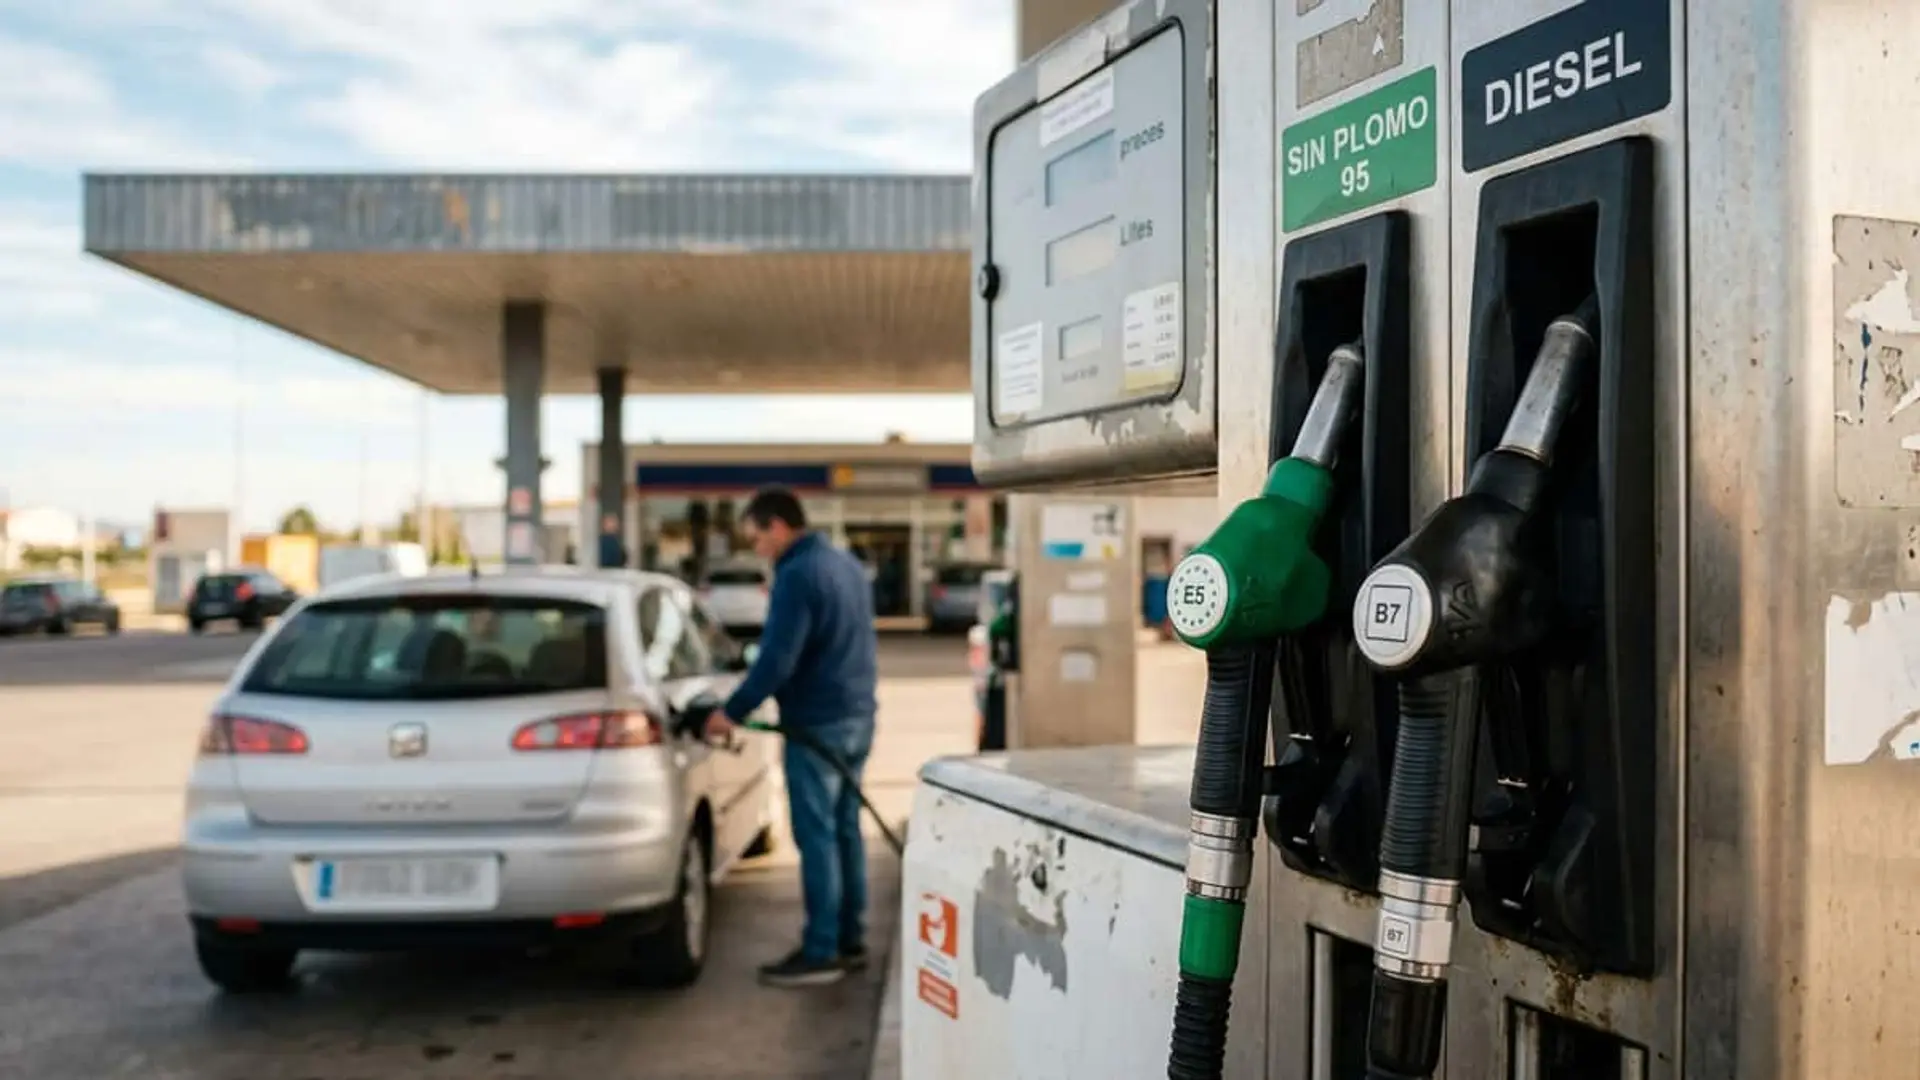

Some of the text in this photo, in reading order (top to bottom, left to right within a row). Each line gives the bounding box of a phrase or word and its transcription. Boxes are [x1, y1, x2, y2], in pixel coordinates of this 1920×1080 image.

[1485, 31, 1642, 125] DIESEL
[1287, 96, 1428, 175] SIN PLOMO
[1341, 159, 1370, 196] 95
[1184, 585, 1204, 605] E5
[1375, 603, 1401, 624] B7
